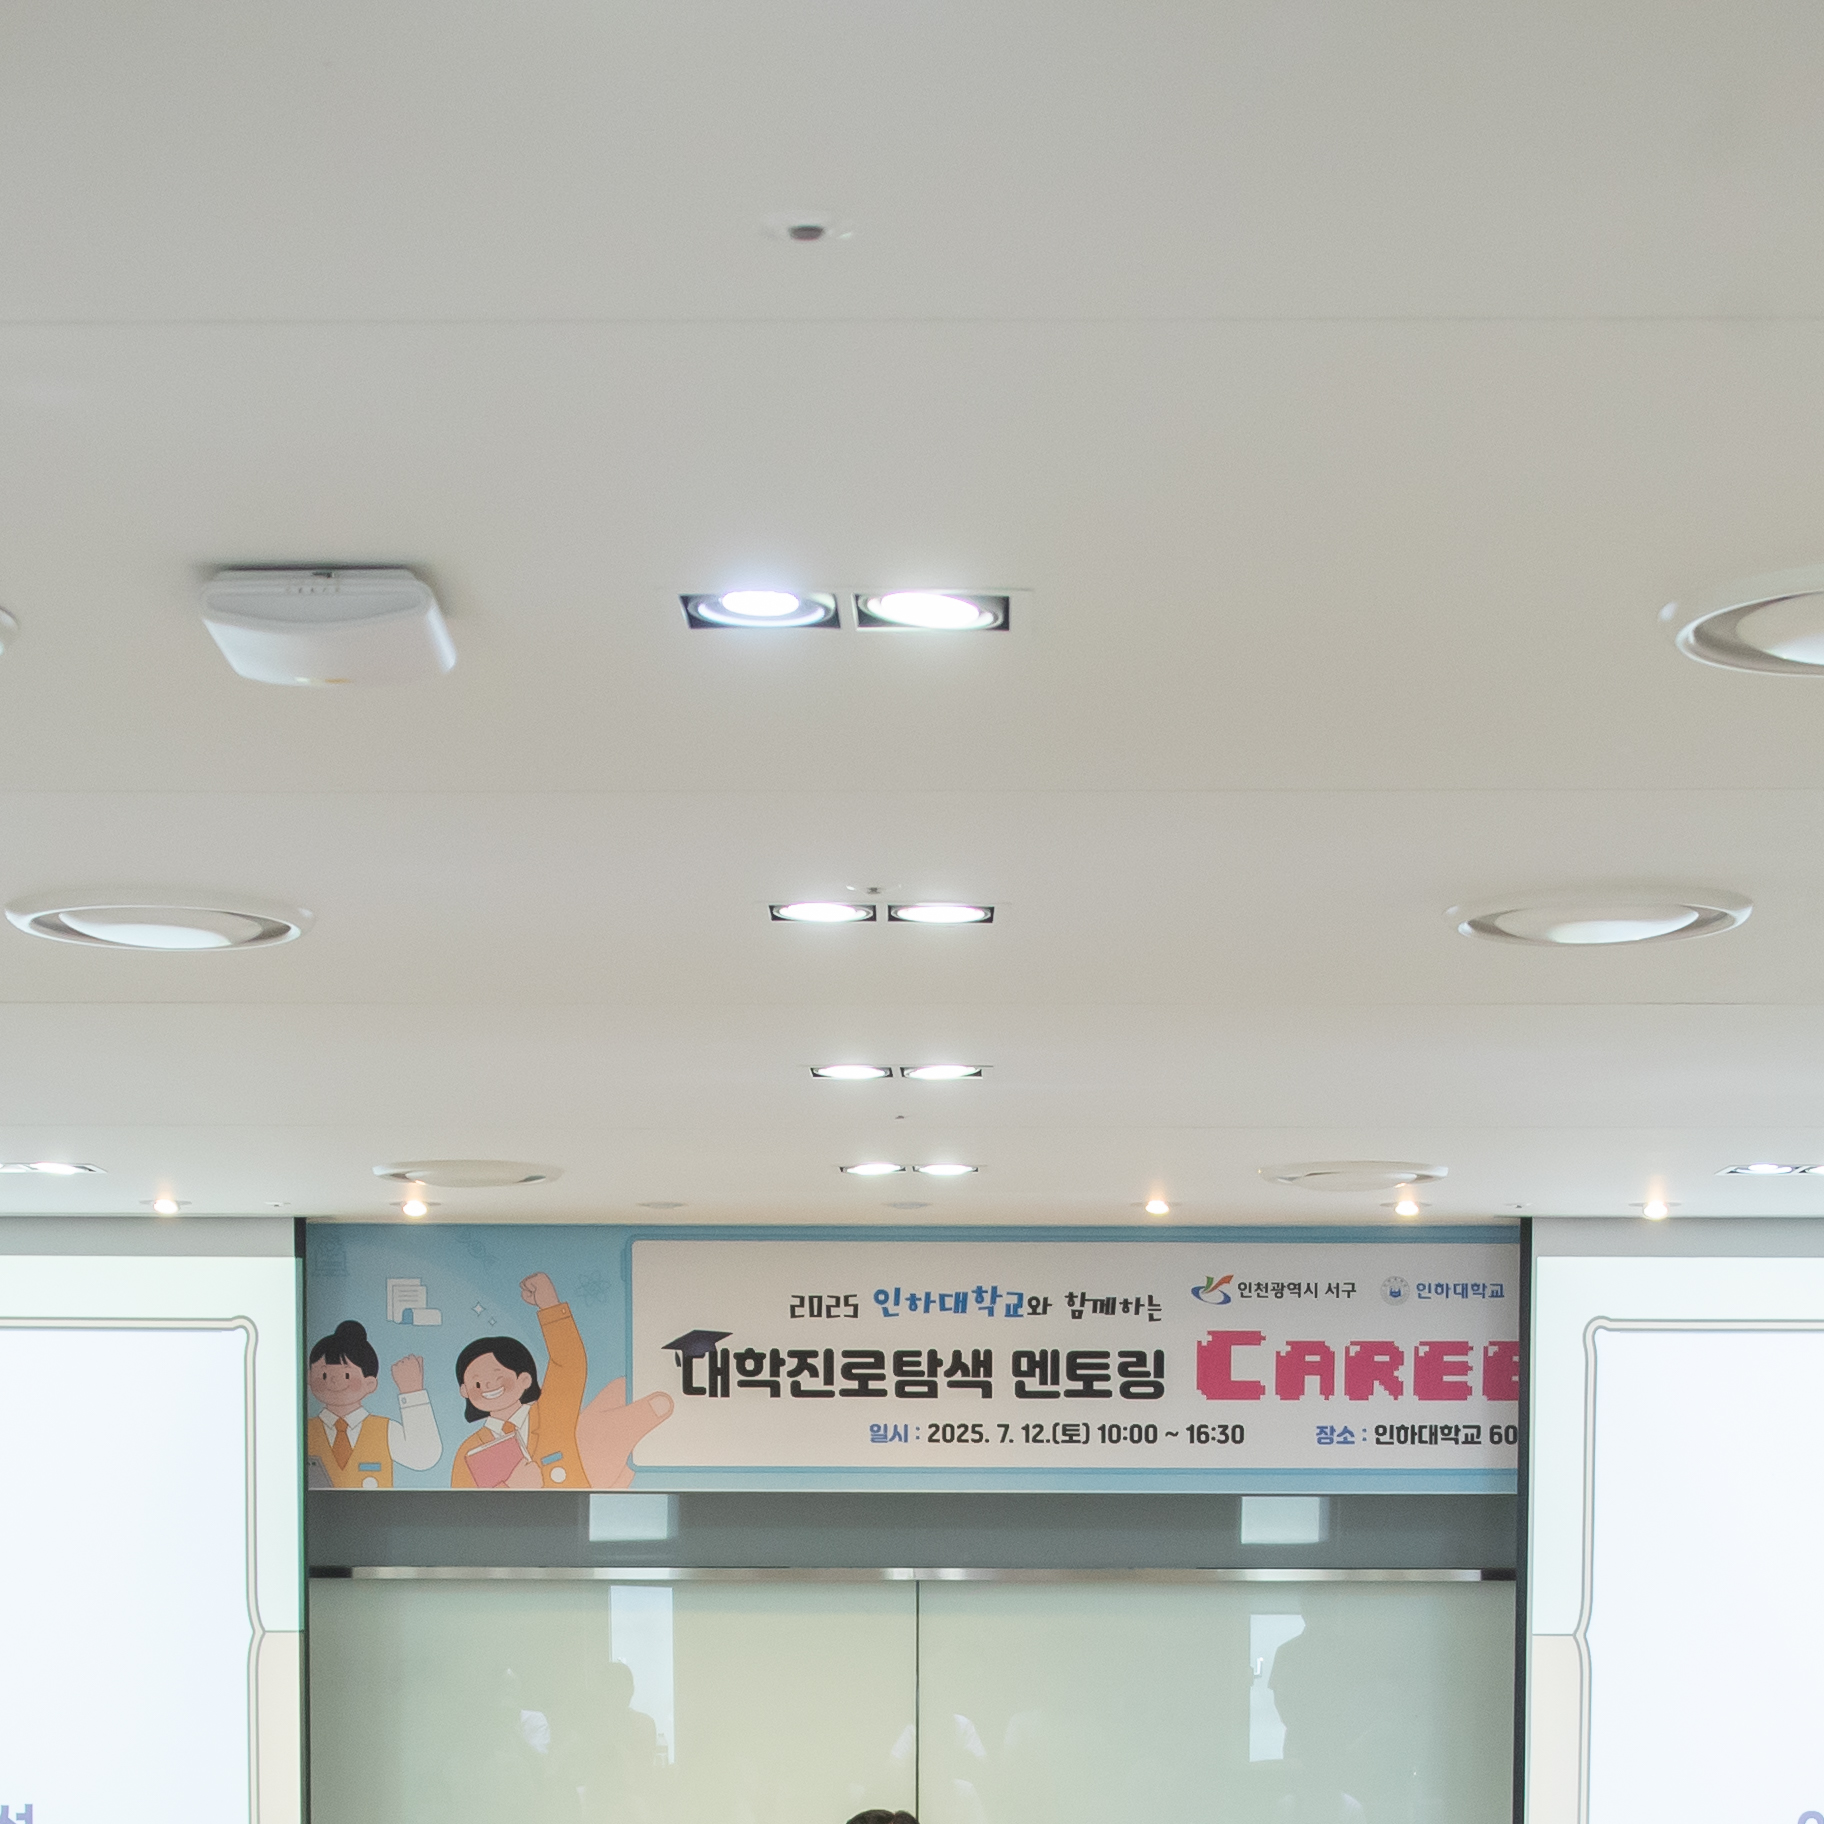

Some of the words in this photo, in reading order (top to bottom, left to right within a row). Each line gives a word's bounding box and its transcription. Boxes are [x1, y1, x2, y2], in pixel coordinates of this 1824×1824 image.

[1237, 1281, 1318, 1299] 인천광역시
[1325, 1281, 1357, 1299] 서구
[1416, 1282, 1505, 1299] 인하대학교
[789, 1294, 859, 1318] 2025
[873, 1285, 1053, 1318] 인하대학교와
[1064, 1291, 1162, 1322] 함께하는
[680, 1347, 993, 1399] 대학진로탐색
[1012, 1348, 1165, 1400] 멘토링
[869, 1423, 908, 1444] 일시
[927, 1423, 990, 1444] 2025.
[997, 1423, 1014, 1444] 7.
[1097, 1423, 1158, 1444] 10:00
[1185, 1423, 1245, 1445] 16:30
[1315, 1424, 1356, 1446] 장소
[1374, 1424, 1482, 1446] 인하대학교
